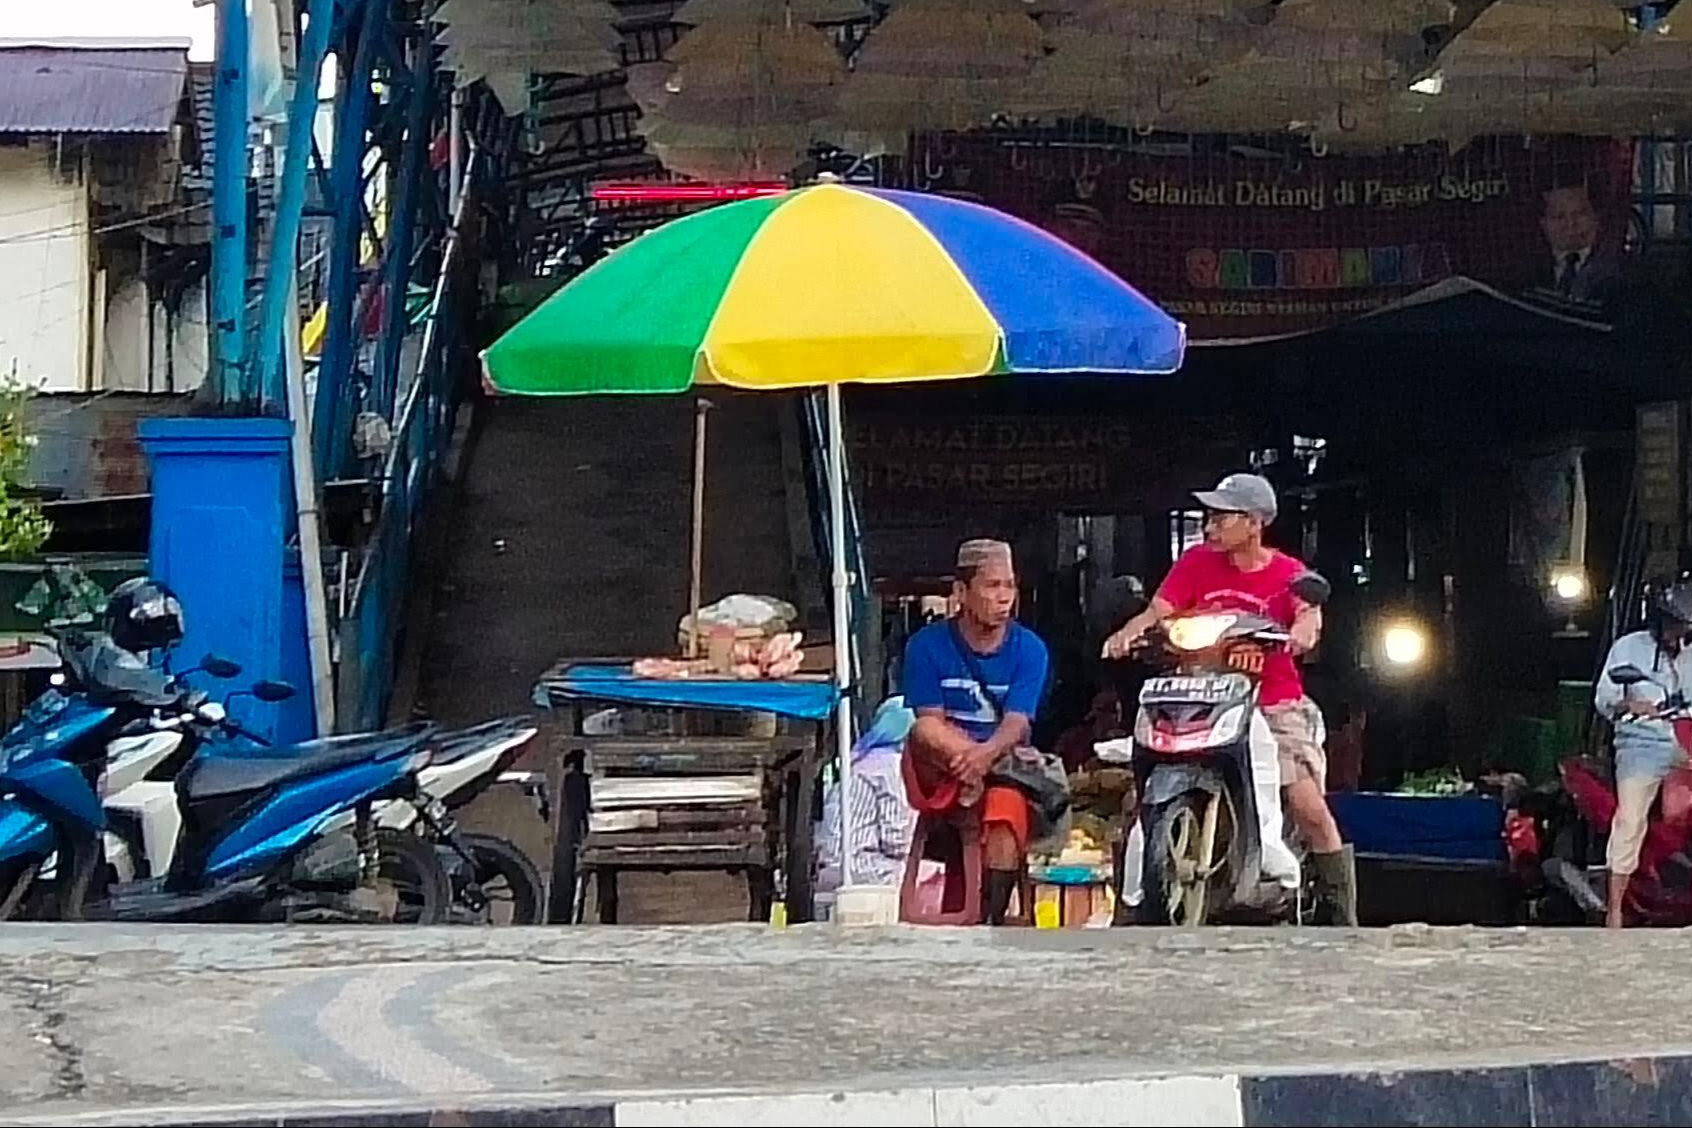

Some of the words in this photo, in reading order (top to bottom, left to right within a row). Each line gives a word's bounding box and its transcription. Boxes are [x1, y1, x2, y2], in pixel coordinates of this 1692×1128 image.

[1128, 176, 1225, 206] Selamat
[1234, 179, 1326, 211] Datang
[1333, 179, 1355, 208] di
[1363, 179, 1432, 208] Pasar
[1438, 172, 1511, 205] Segiri
[997, 424, 1132, 450] DATANG
